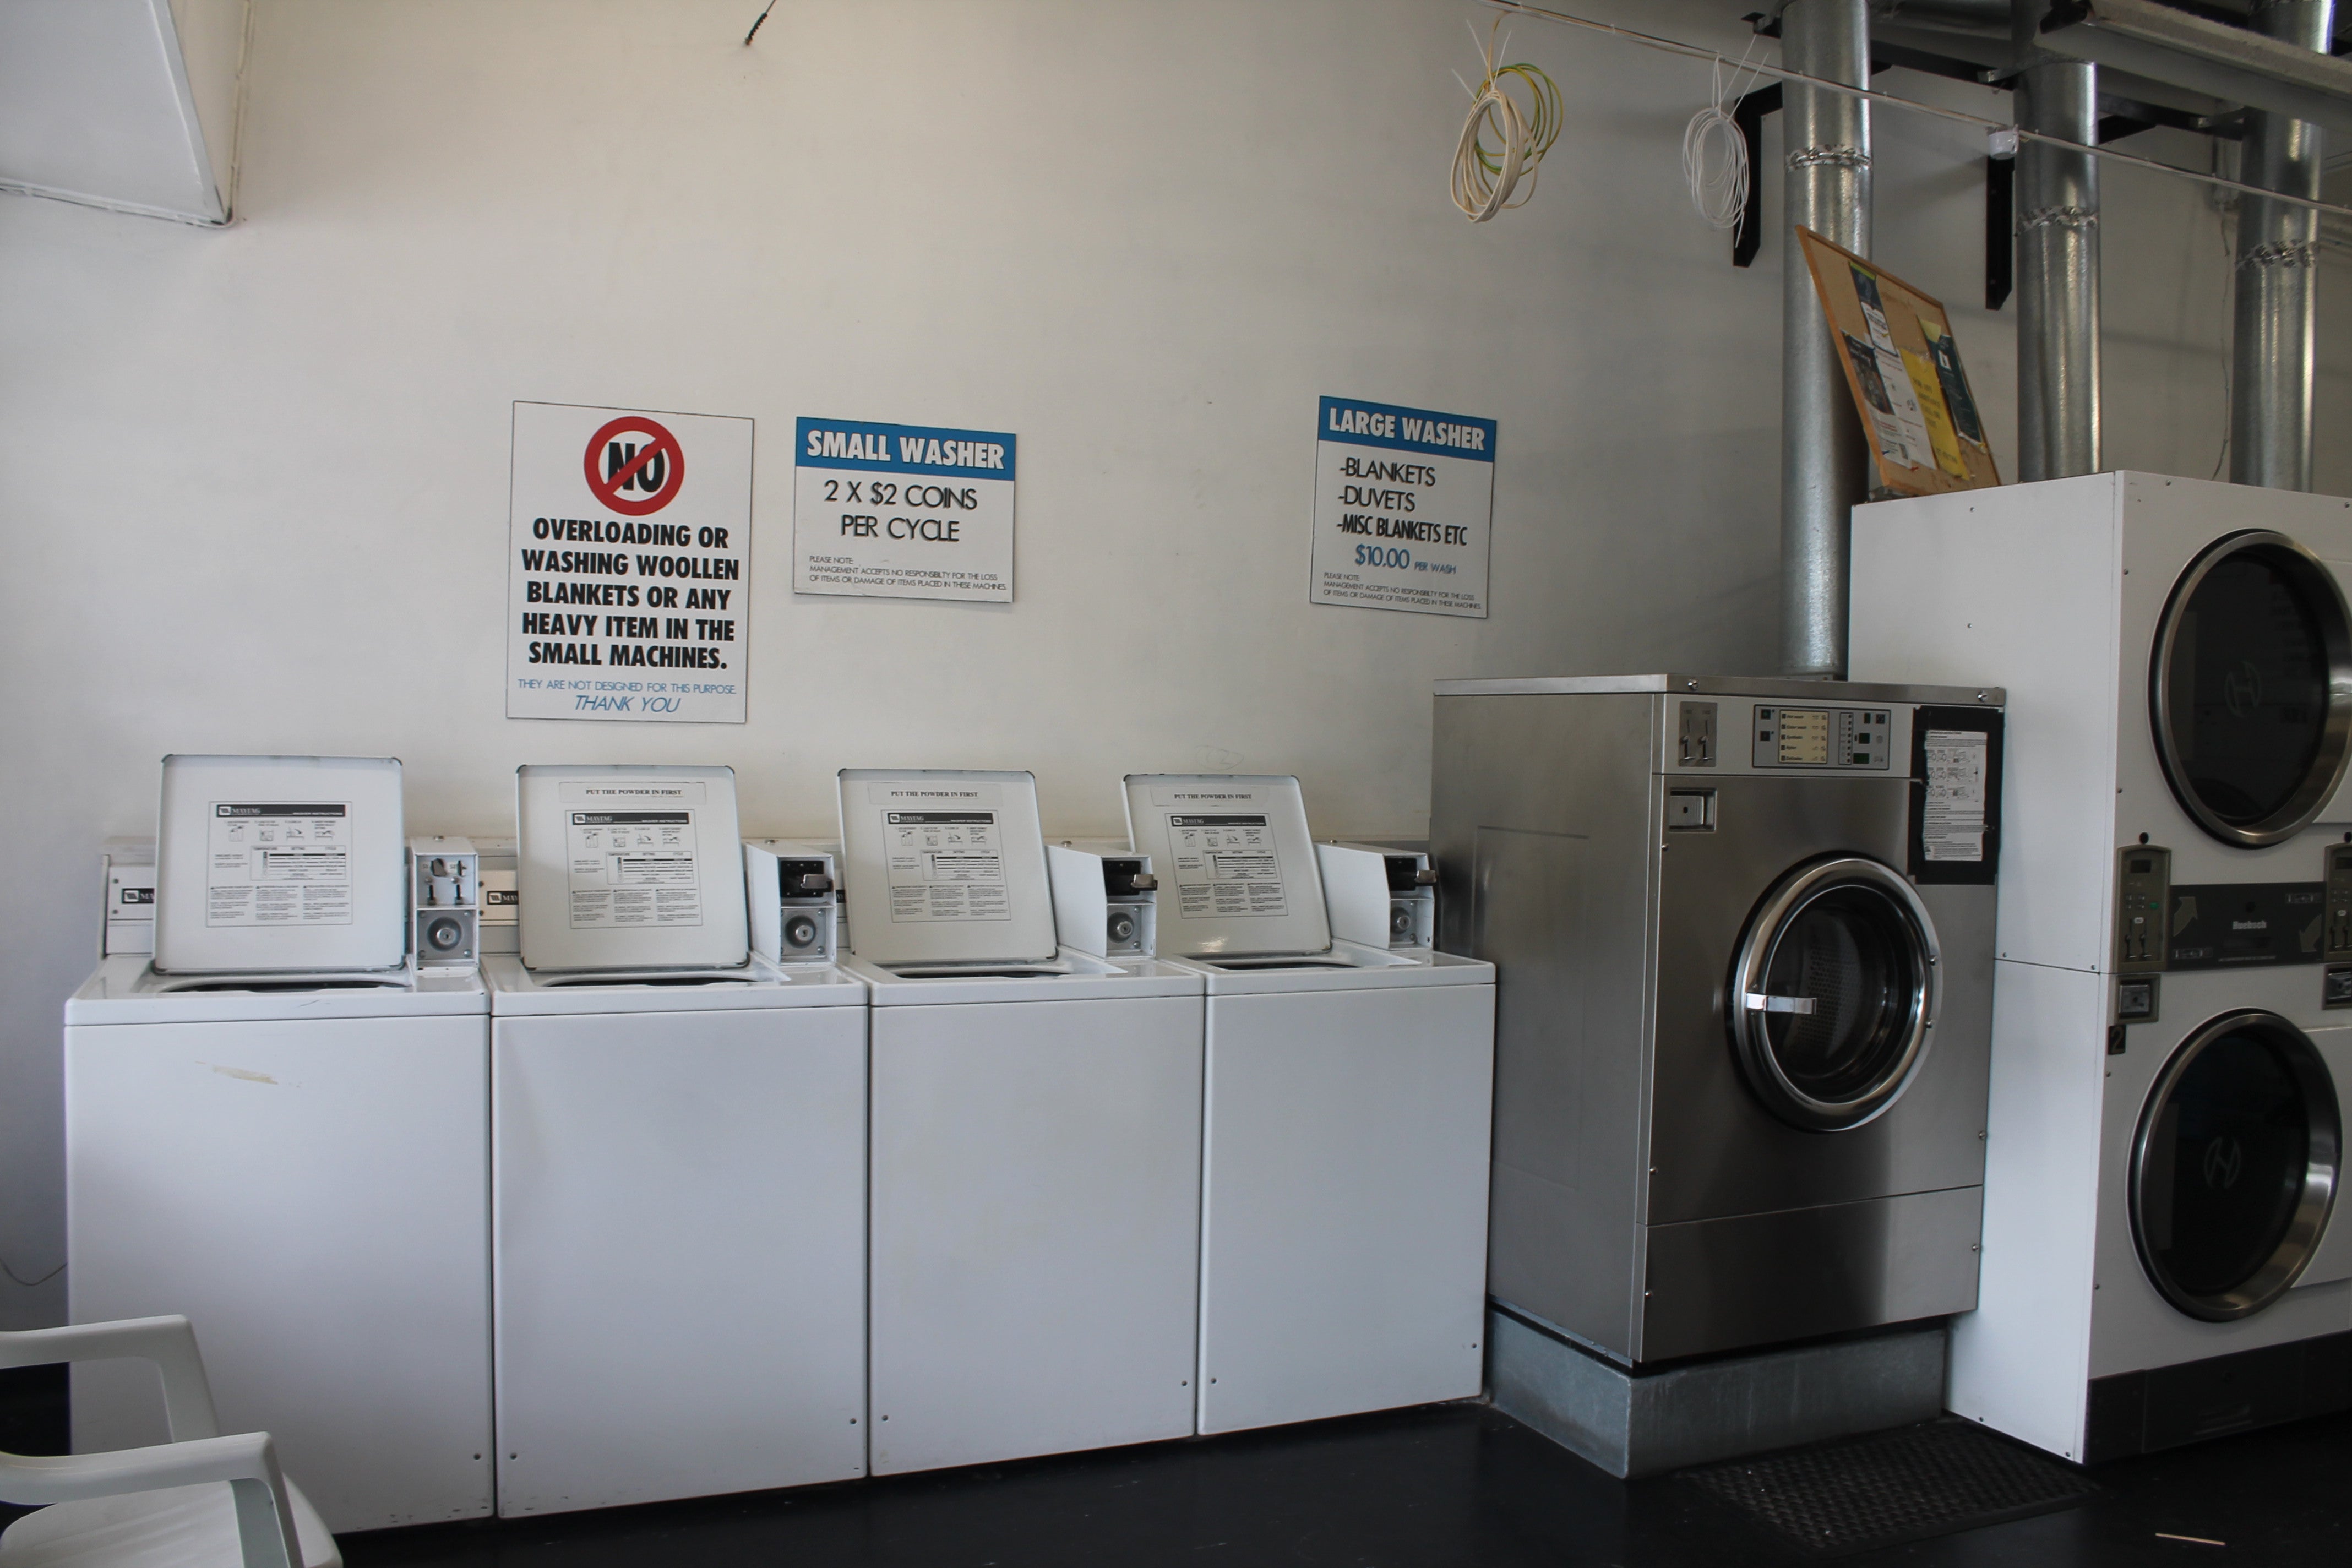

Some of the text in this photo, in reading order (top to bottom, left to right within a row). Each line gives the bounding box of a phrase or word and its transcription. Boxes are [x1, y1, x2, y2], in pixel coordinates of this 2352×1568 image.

[1329, 407, 1485, 450] LARGE WASHER
[807, 429, 1005, 470] SMALL WASHER
[607, 442, 665, 493] NO
[1340, 456, 1436, 487] -BLANKETS
[824, 479, 978, 510] 2 X $2 COINS
[1338, 485, 1416, 512] -DUVETS
[533, 518, 729, 548] OVERLOADING OR
[841, 514, 960, 542] PER CYCLE
[1337, 513, 1468, 546] -MISC BLANKETS ETC
[521, 549, 739, 580] WASHING WOOLLEN
[809, 556, 832, 564] PLEASE
[809, 566, 859, 574] MANAGEMENT
[861, 568, 890, 576] ACCEPTS
[1355, 543, 1457, 574] $10.00 PER WASH
[821, 575, 840, 583] ITEMS
[854, 576, 884, 585] DAMAGE
[897, 579, 916, 587] ITEMS
[918, 579, 942, 588] PLACED
[1324, 581, 1364, 590] MANAGEMENT
[1365, 585, 1390, 593] ACCEPTS
[527, 581, 731, 611] BLANKETS OR ANY
[1359, 592, 1385, 601] DAMAGE
[1411, 597, 1430, 605] PLACED
[522, 612, 735, 641] HEAVY ITEM IN THE
[529, 641, 727, 669] SMALL MACHINES.
[518, 678, 543, 689] THEY
[547, 680, 565, 690] ARE
[568, 680, 591, 691] NOT
[595, 681, 643, 692] DESIGNED
[647, 683, 667, 693] FOR
[671, 683, 690, 693] THIS
[574, 695, 681, 712] THANK YOU
[2111, 1027, 2125, 1051] 2
